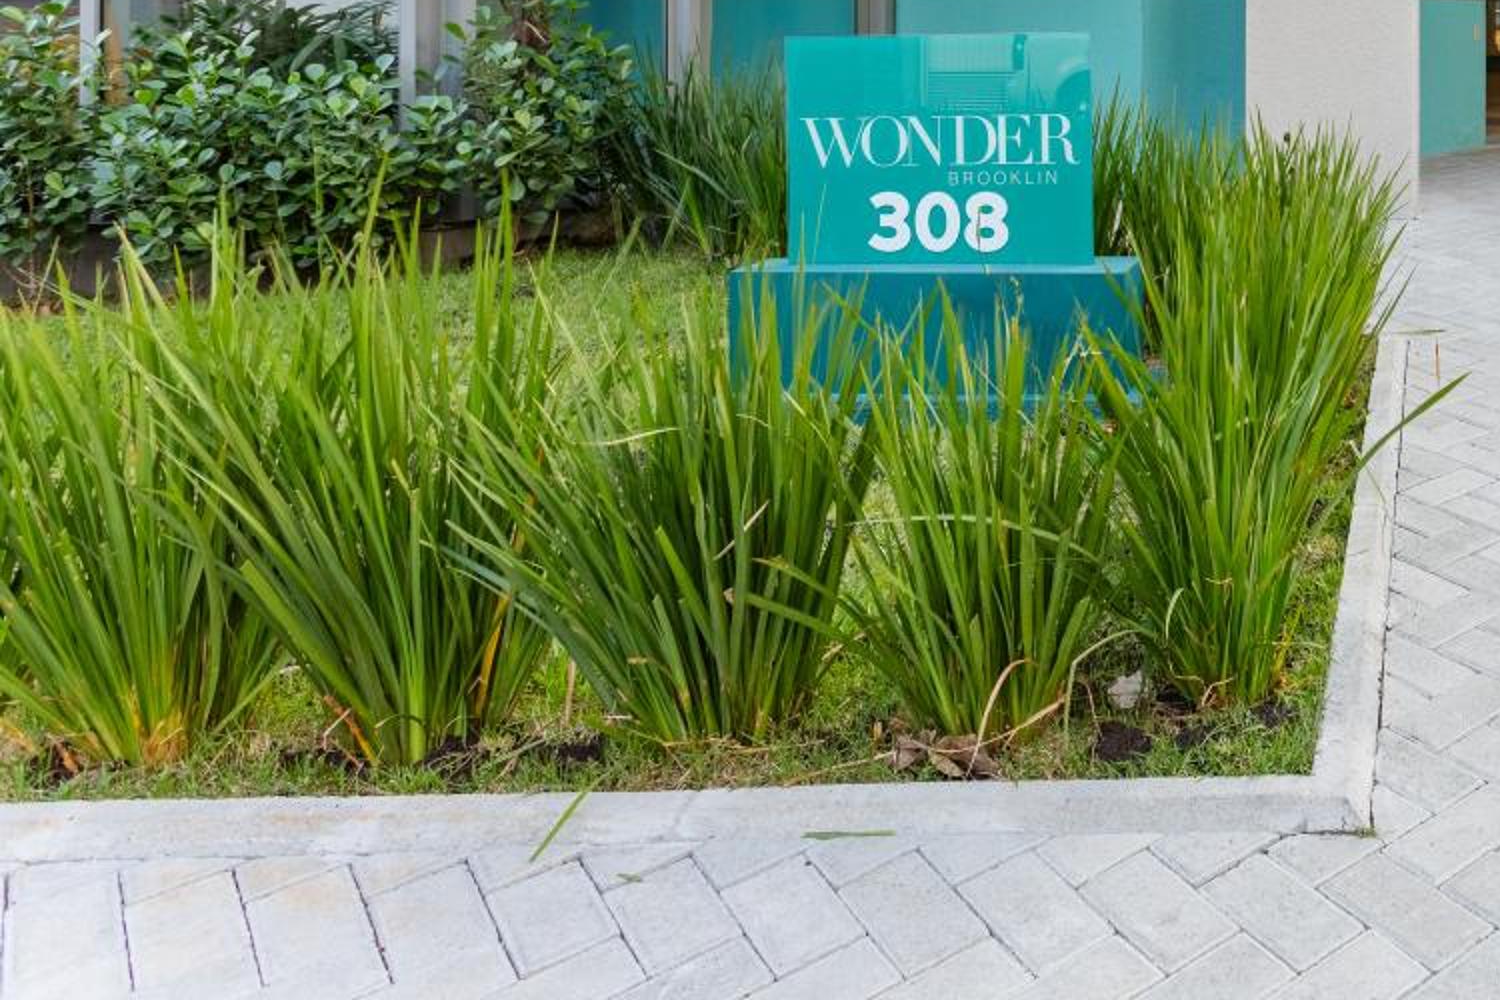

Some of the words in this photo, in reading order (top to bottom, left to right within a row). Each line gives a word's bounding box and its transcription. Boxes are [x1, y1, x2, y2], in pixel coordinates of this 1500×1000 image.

[799, 113, 1080, 168] WONDER
[948, 170, 1058, 186] BROOKLIN
[867, 191, 1009, 252] 308
